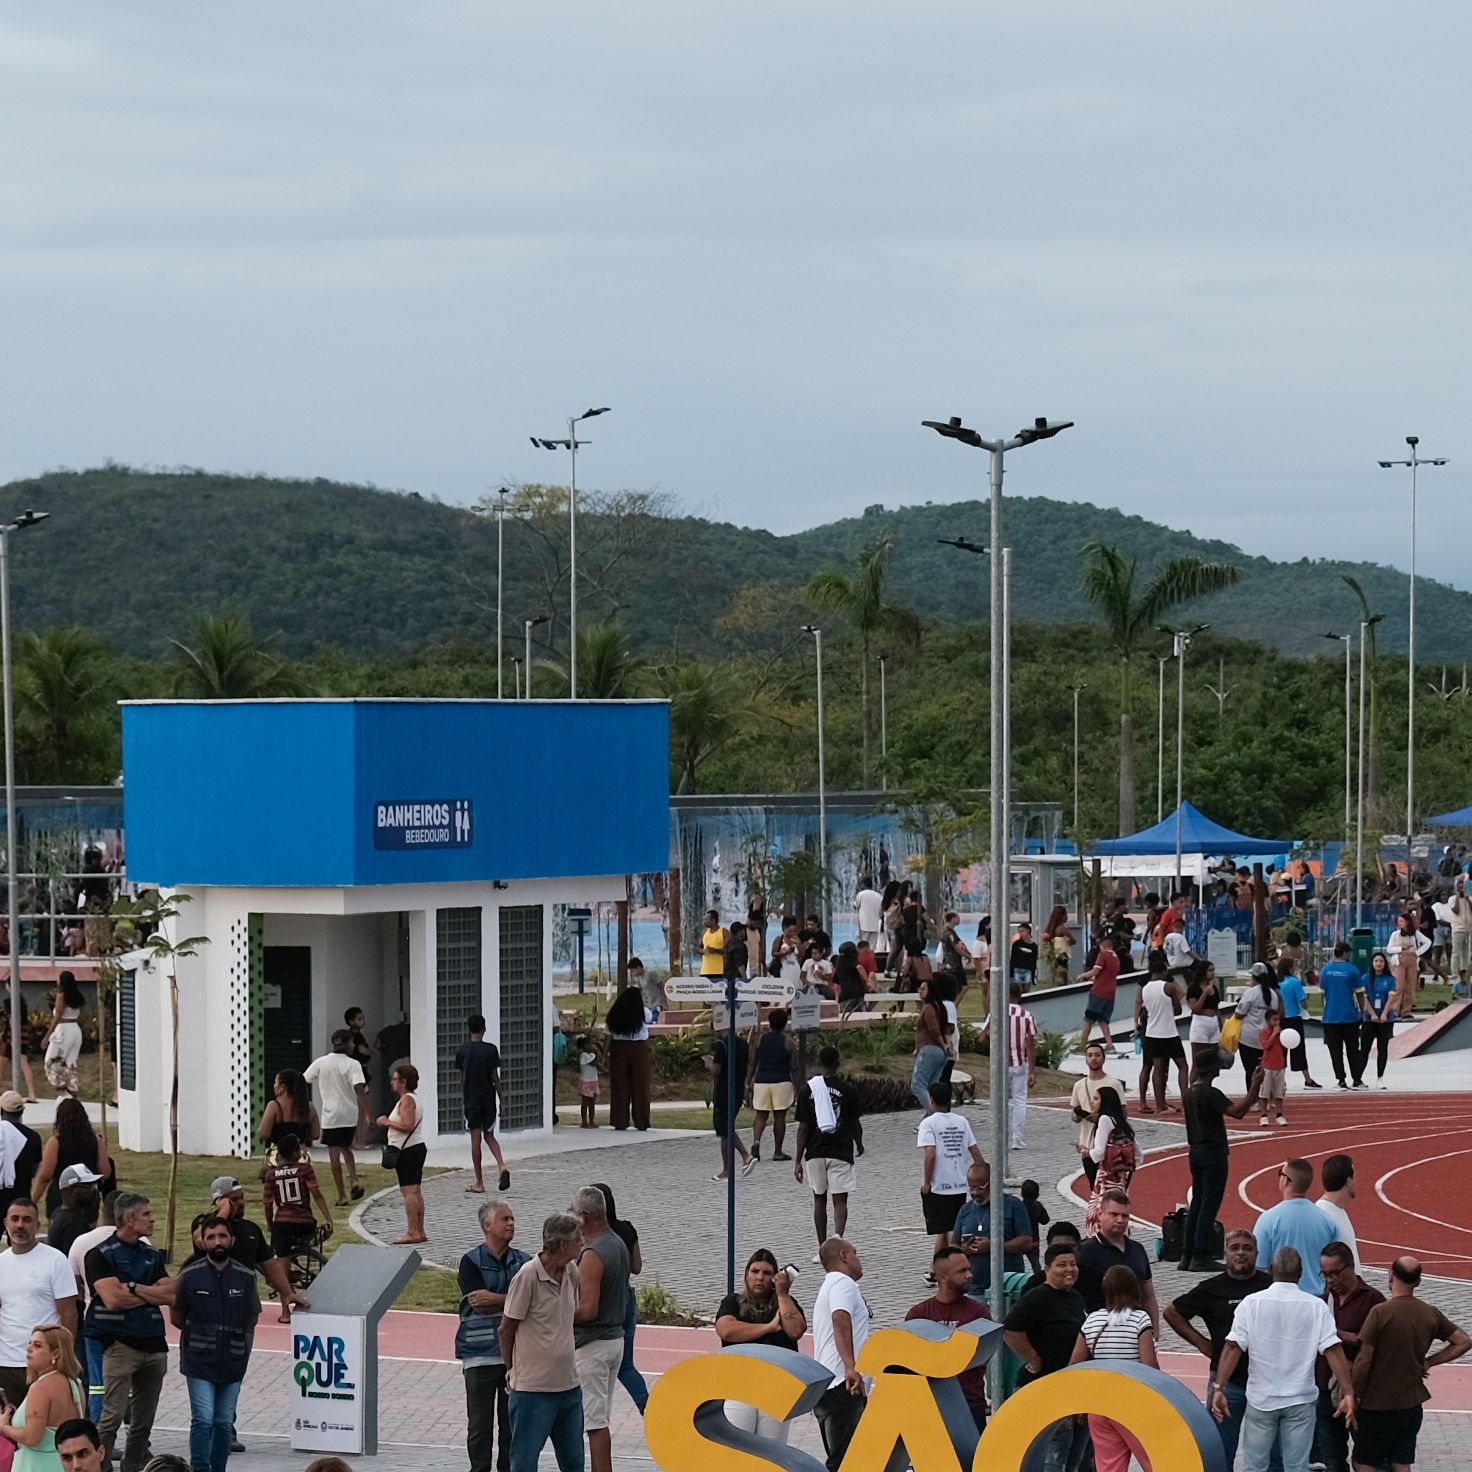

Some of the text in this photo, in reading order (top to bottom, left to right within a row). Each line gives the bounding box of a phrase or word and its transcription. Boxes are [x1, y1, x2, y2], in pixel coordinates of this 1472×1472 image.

[377, 804, 450, 828] BANHEIROS
[405, 828, 450, 844] BEBEDOURO
[275, 1177, 302, 1203] 10
[293, 1334, 346, 1362] PAR
[293, 1360, 349, 1398] QUE
